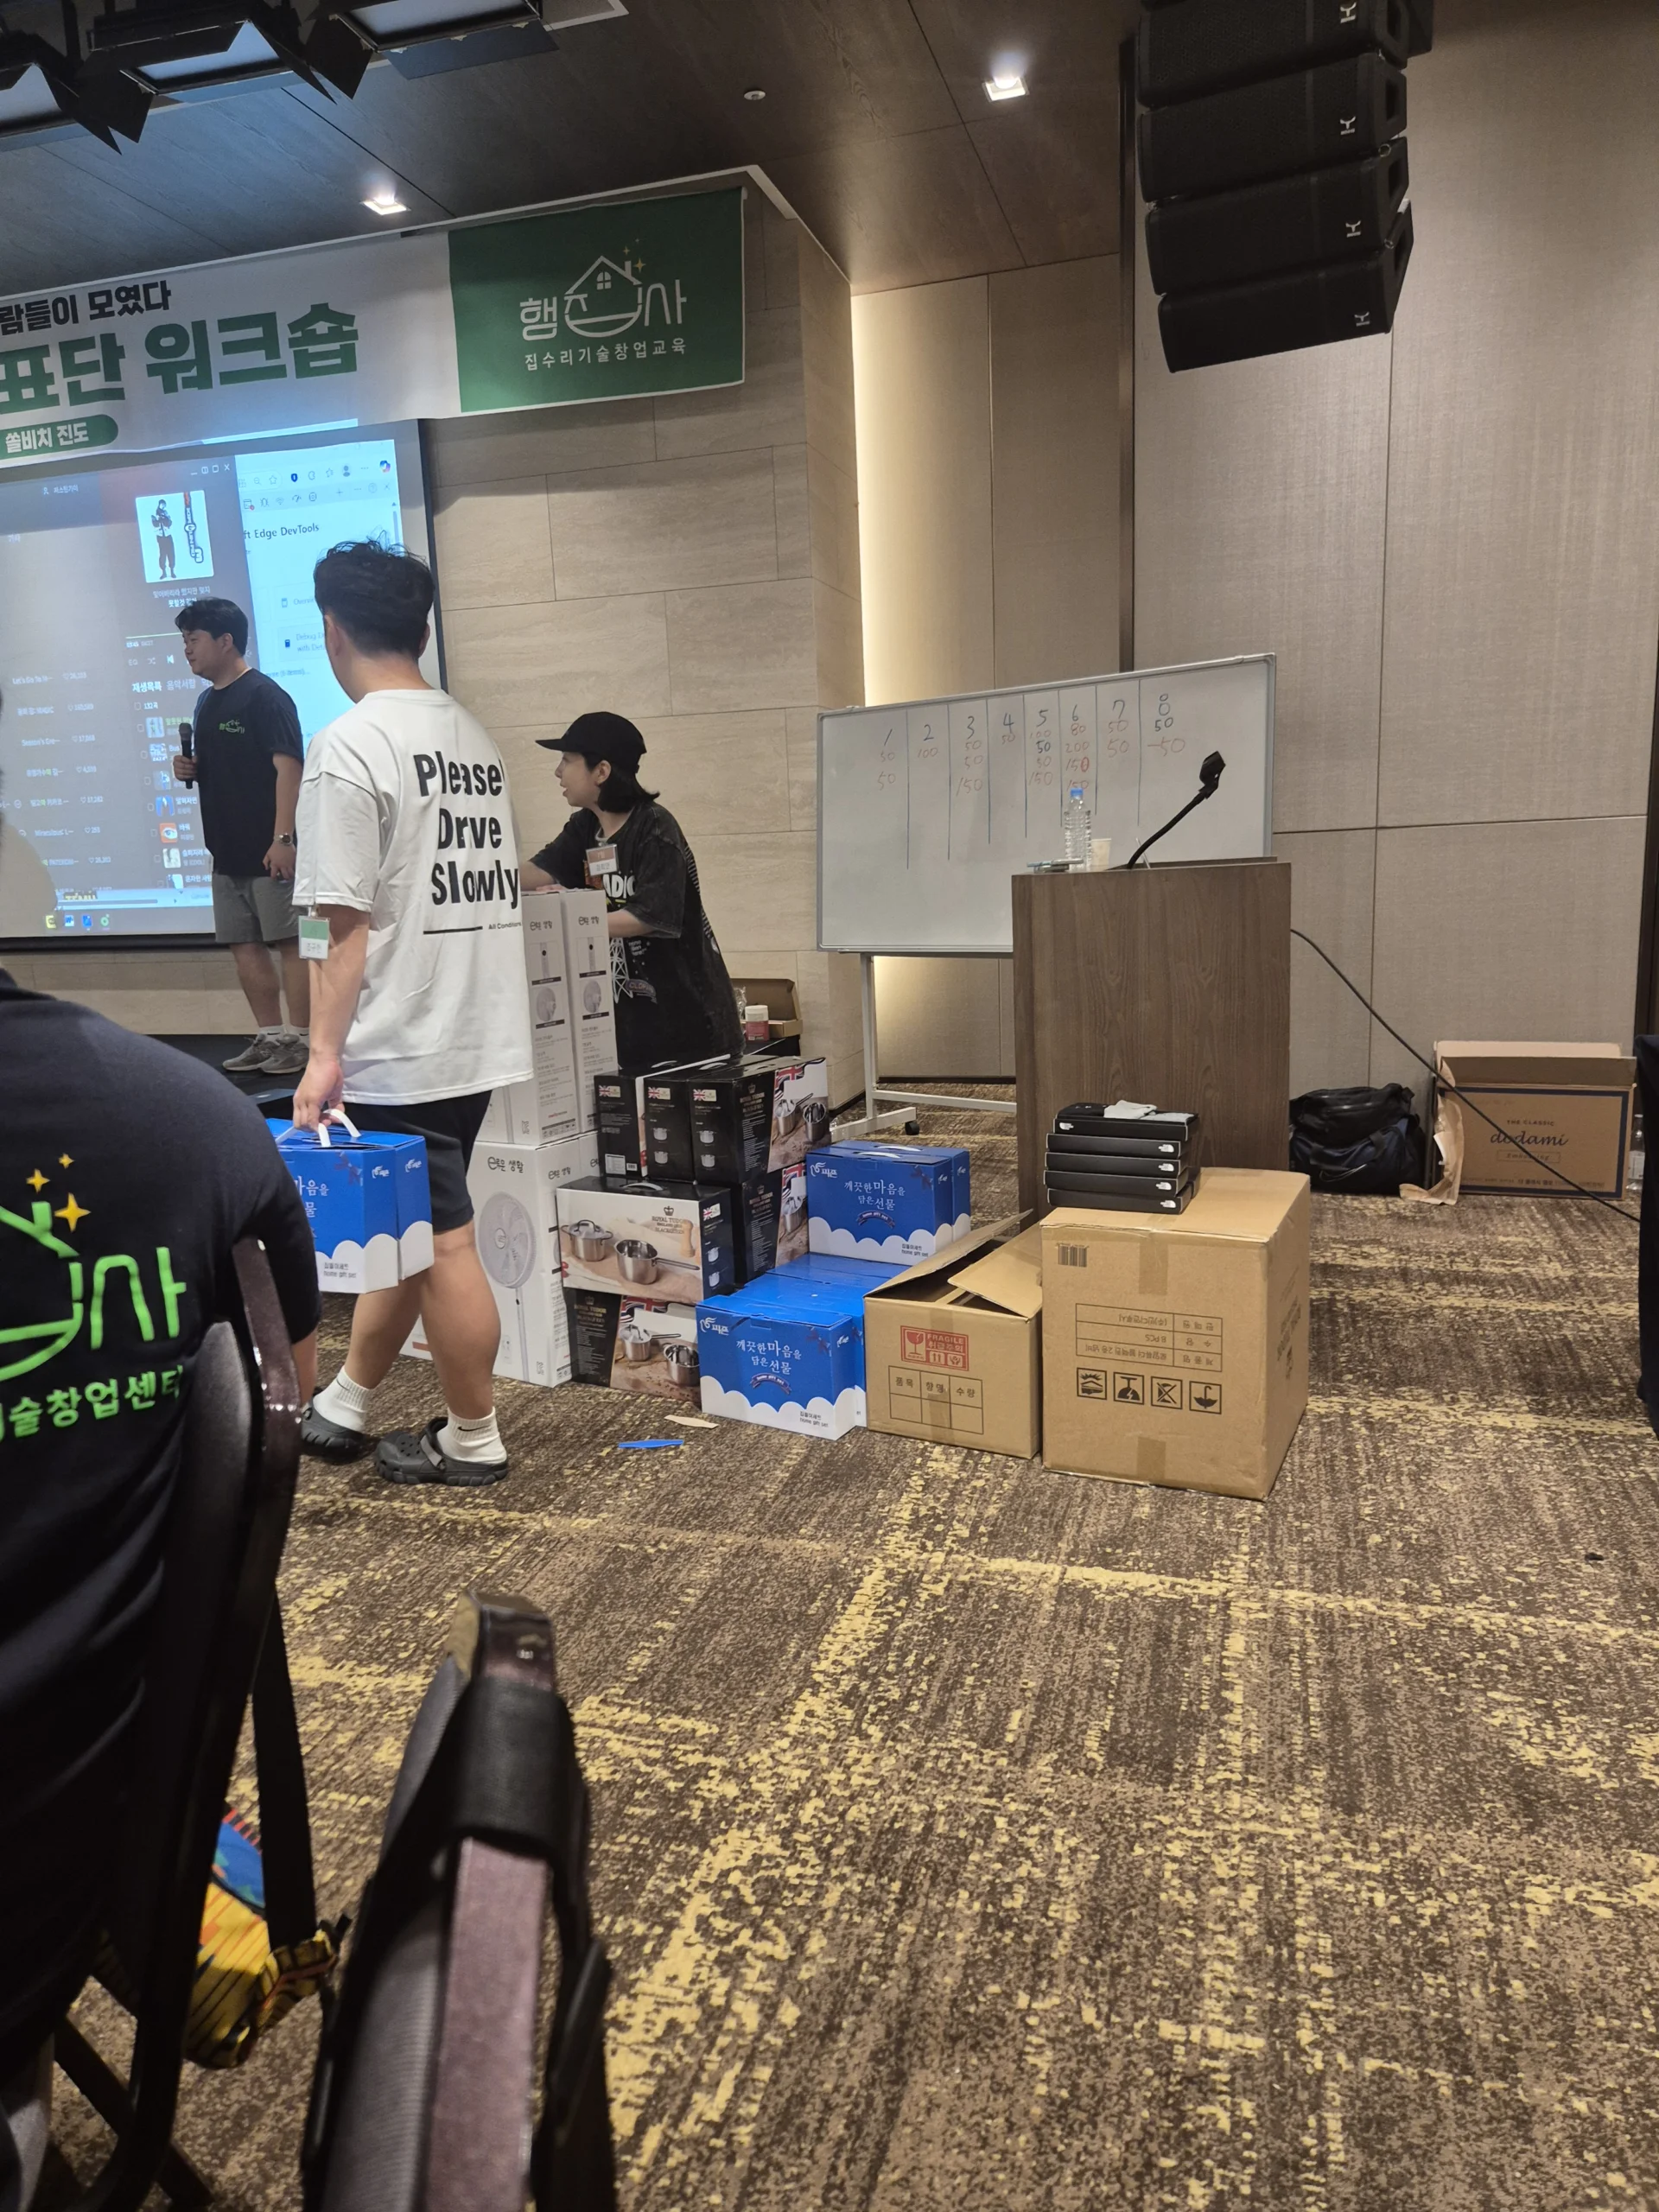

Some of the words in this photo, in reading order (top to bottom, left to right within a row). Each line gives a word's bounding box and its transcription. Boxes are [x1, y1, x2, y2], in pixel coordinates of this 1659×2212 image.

[0, 295, 79, 335] 람들이
[88, 280, 172, 321] 모였다
[144, 302, 359, 395] 워크숍
[524, 338, 687, 371] 집수리기술창업교육
[4, 427, 53, 454] 쏠비치
[57, 422, 89, 447] 진도
[254, 529, 277, 540] Edge
[281, 523, 320, 536] DevTools
[132, 681, 162, 693] 재생목록
[1071, 704, 1079, 721] 6
[1113, 699, 1125, 719] 7
[1003, 712, 1014, 734] 4
[1037, 709, 1048, 727] 5
[1154, 717, 1173, 732] 50
[924, 724, 934, 741] 2
[967, 715, 975, 739] 3
[1109, 720, 1129, 734] 50
[918, 747, 938, 758] 100
[1036, 741, 1051, 753] 50
[1065, 741, 1090, 753] 200
[413, 751, 502, 797] Please
[438, 808, 502, 849] Drve
[432, 860, 518, 909] Slowly
[1490, 1130, 1569, 1147] dodami
[927, 1333, 963, 1344] FRAGILE
[928, 1341, 963, 1352] 취급주의
[1145, 1334, 1160, 1343] PCS
[0, 1365, 183, 1442] 술창업센터
